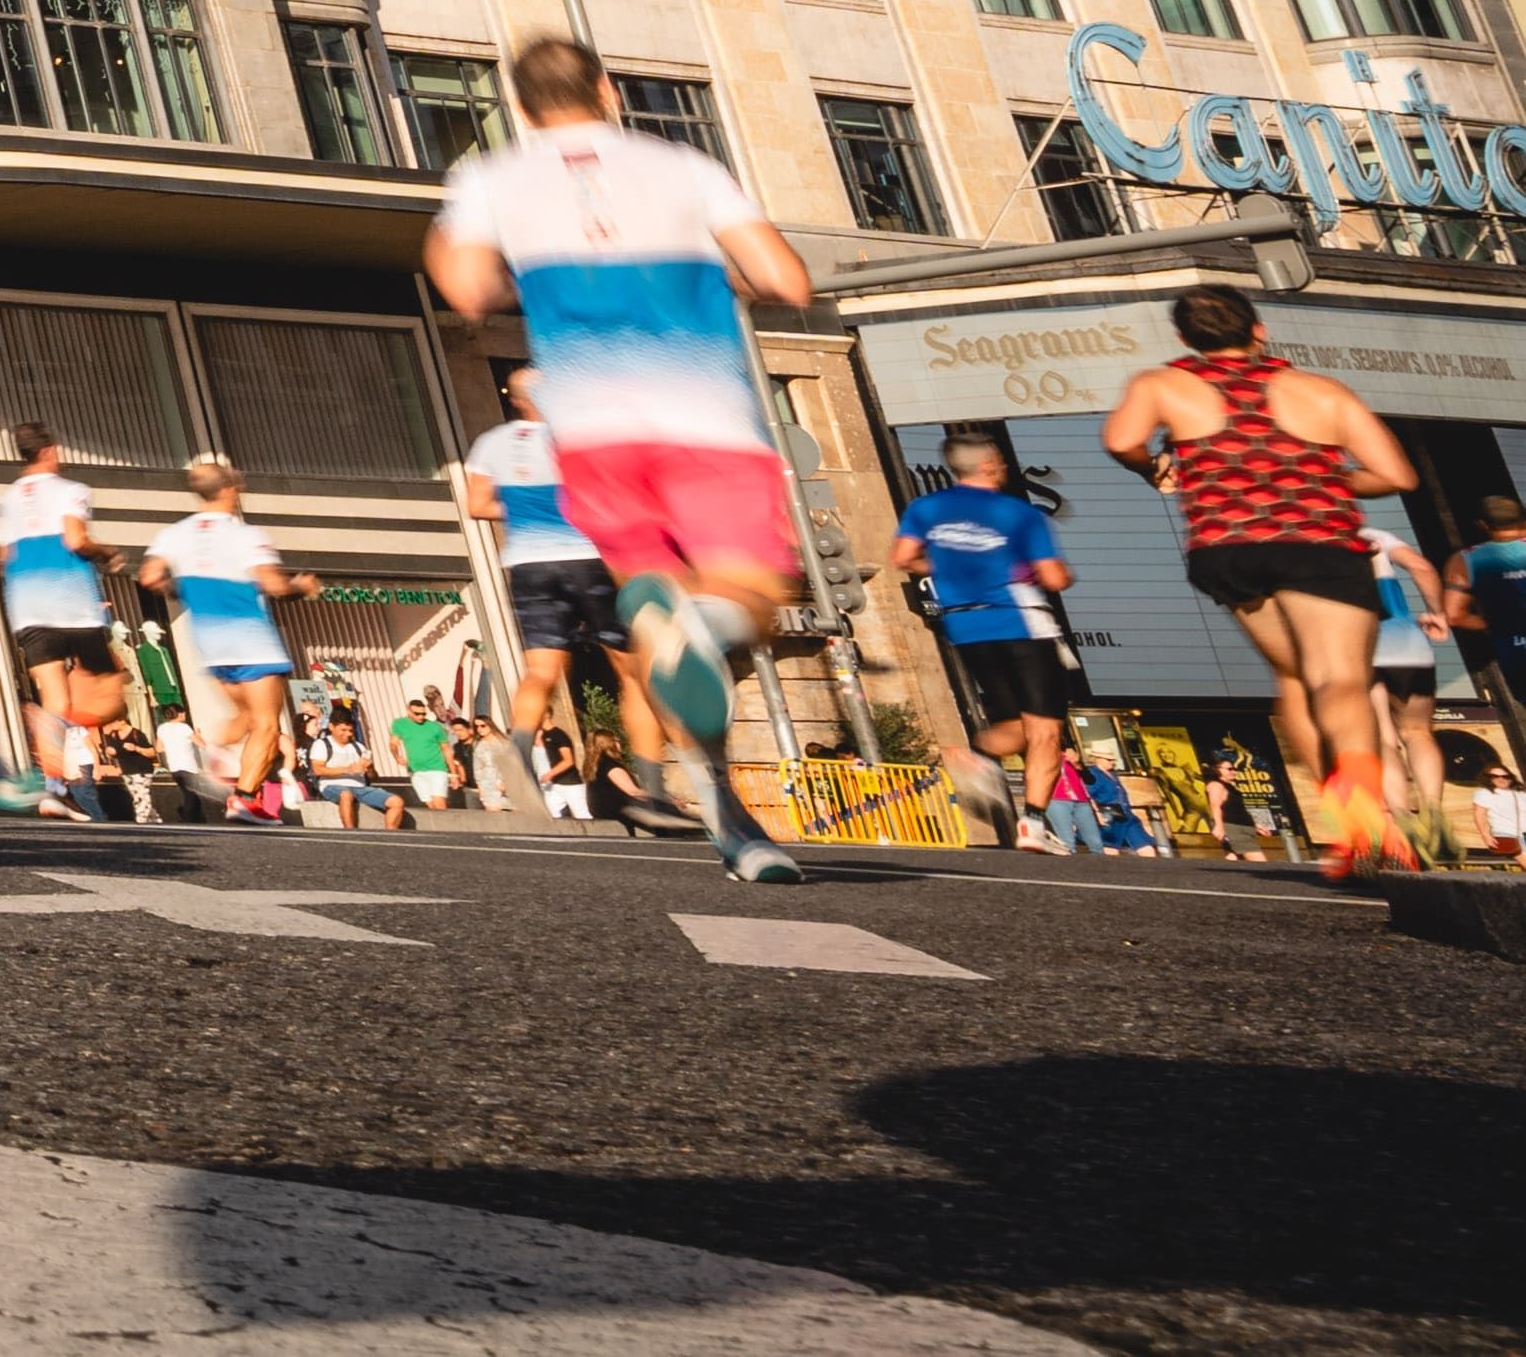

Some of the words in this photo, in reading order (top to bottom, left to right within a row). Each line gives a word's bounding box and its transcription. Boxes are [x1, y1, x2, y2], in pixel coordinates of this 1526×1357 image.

[923, 321, 1141, 371] Seagram's
[1312, 344, 1352, 370] 100%
[323, 586, 375, 604] COLORS
[376, 587, 393, 605] OF
[396, 588, 463, 605] BENETTON
[1072, 631, 1122, 647] OHOL.
